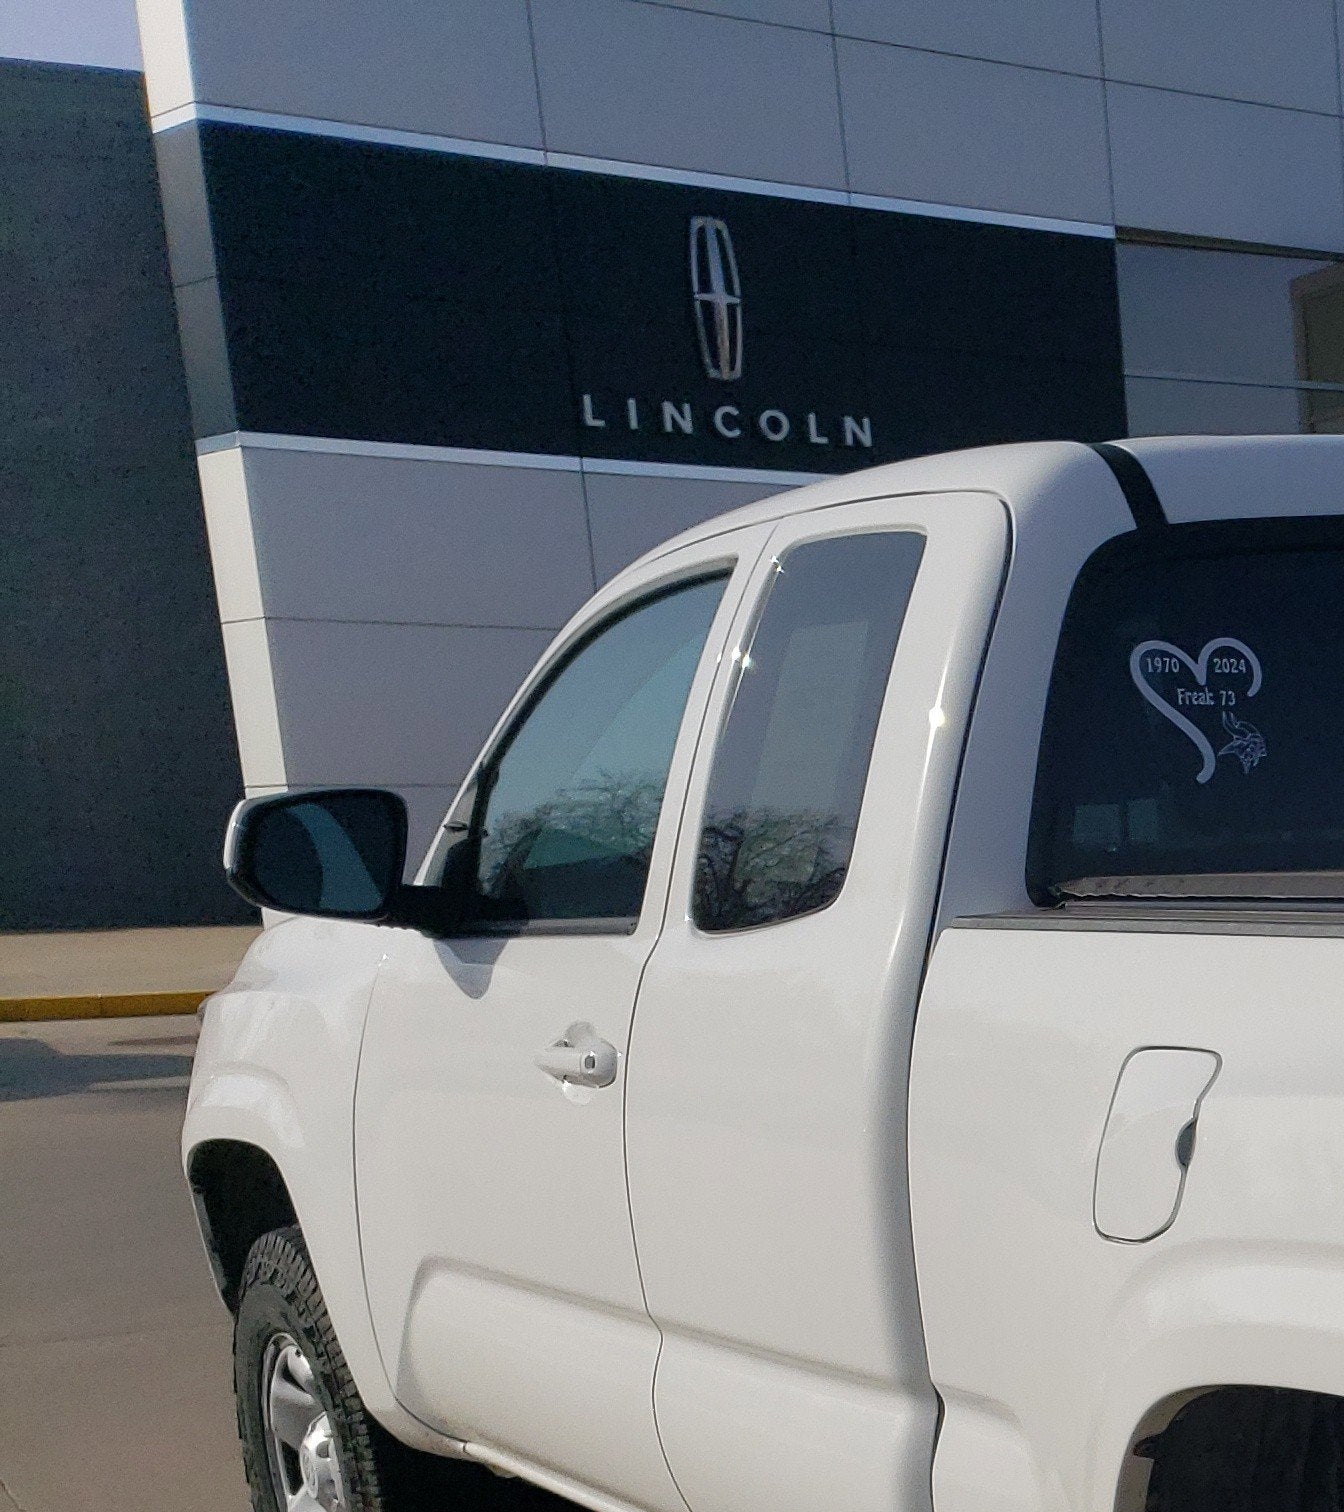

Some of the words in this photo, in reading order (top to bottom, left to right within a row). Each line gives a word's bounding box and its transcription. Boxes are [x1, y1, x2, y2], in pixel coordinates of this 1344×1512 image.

[582, 393, 873, 448] LINCOLN
[1146, 657, 1180, 673] 1970
[1213, 658, 1247, 674] 2024
[1219, 690, 1236, 706] 73
